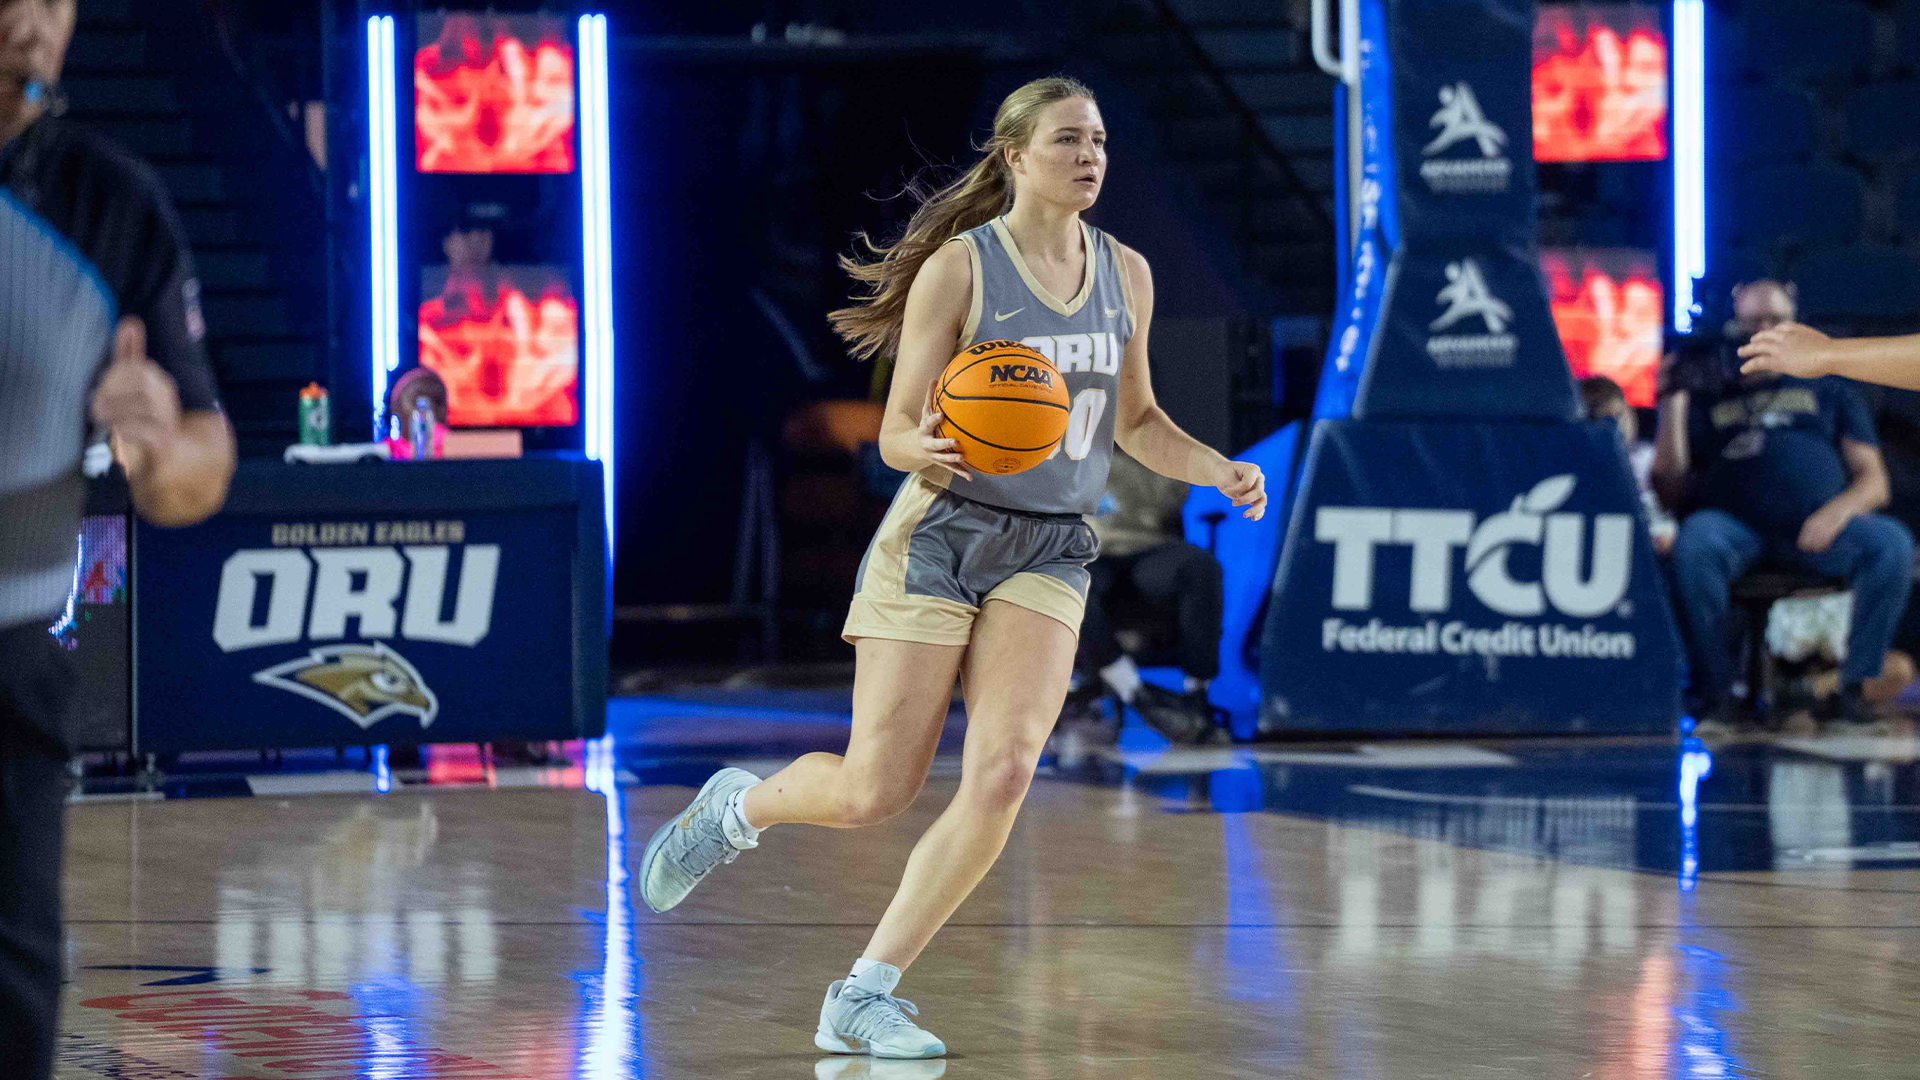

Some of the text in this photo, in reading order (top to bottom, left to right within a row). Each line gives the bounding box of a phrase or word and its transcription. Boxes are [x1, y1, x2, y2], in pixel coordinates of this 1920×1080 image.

[990, 364, 1053, 389] NCAA
[1046, 388, 1108, 461] 0
[271, 520, 465, 546] GOLDEN EAGLES
[1315, 506, 1632, 617] TTCU
[212, 543, 500, 653] ORU
[1322, 617, 1636, 659] Federal Credit Union
